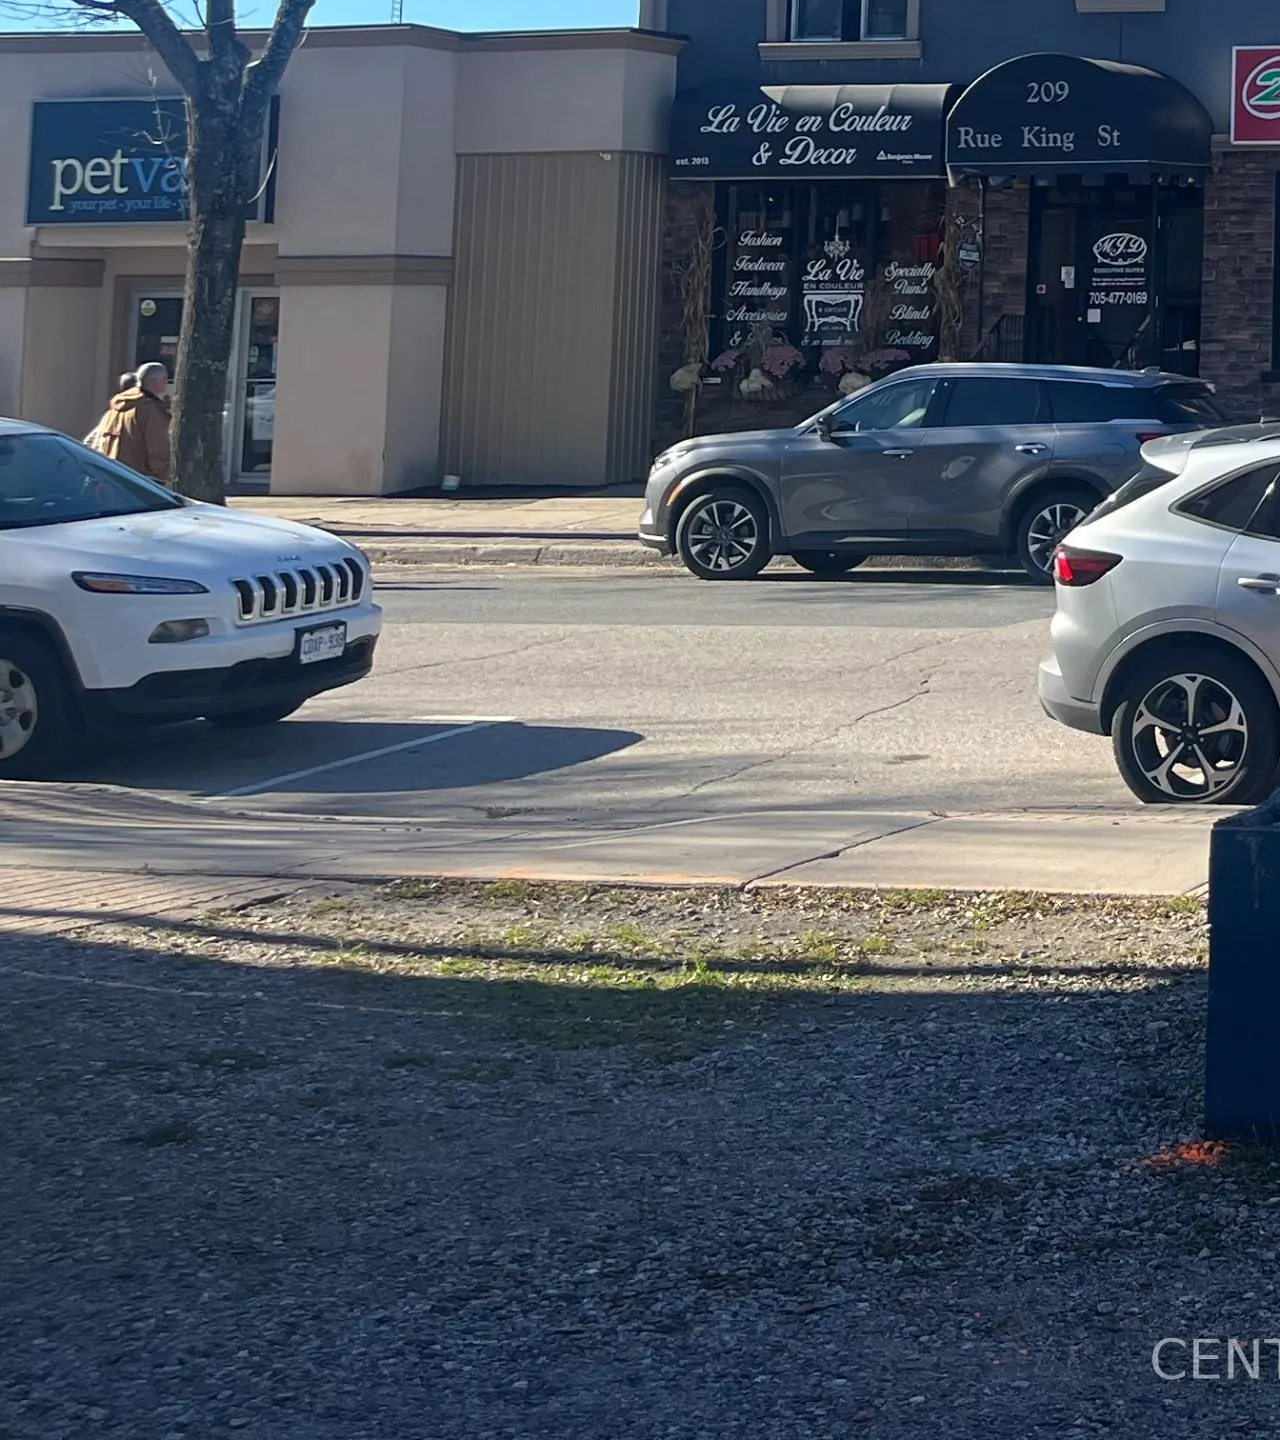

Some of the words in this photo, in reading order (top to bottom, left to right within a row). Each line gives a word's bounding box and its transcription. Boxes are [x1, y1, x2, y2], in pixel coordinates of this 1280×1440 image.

[1026, 81, 1070, 103] 209
[700, 104, 741, 133] La
[746, 104, 789, 133] Vie
[795, 114, 824, 132] en
[828, 102, 913, 132] Couleur
[957, 126, 1003, 148] Rue
[1021, 126, 1075, 152] King
[1097, 124, 1121, 147] St
[752, 142, 773, 166] &
[779, 135, 858, 166] Decor
[737, 230, 783, 247] Fashion
[732, 255, 786, 272] Footwear
[802, 259, 832, 281] La
[836, 259, 865, 281] Vie
[728, 280, 788, 301] Handbags
[803, 282, 817, 290] EN
[819, 282, 865, 290] COULEUR
[1088, 291, 1148, 305] 705-477-0169
[889, 304, 930, 320] Blinds
[729, 330, 743, 347] &
[885, 329, 935, 350] Bedding
